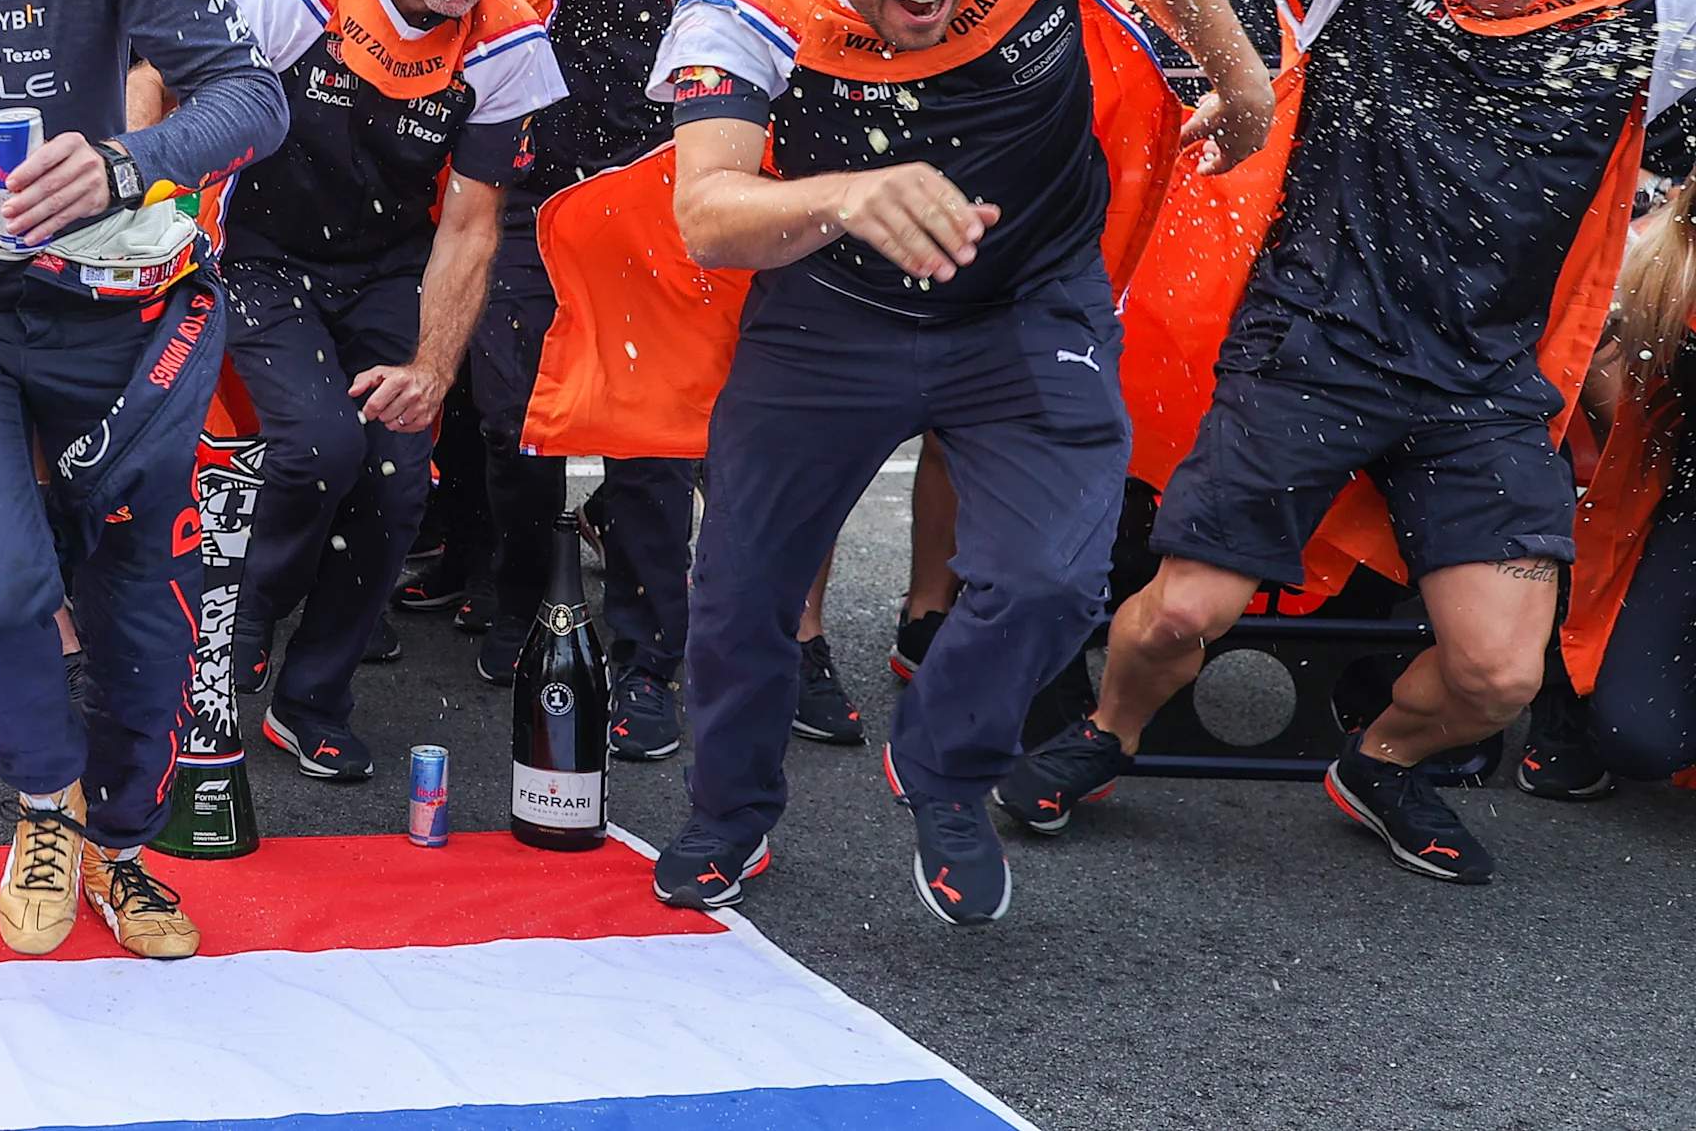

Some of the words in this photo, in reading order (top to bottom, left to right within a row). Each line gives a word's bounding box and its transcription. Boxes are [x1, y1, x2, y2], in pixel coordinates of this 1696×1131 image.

[1018, 4, 1066, 49] Tezos
[3, 47, 52, 64] Tezos
[342, 15, 368, 46] WIJ
[366, 39, 394, 73] ZIJN
[392, 55, 446, 79] ORANJE
[310, 65, 350, 89] Mobil
[305, 88, 355, 108] ORACL
[832, 77, 891, 103] Mobil
[407, 97, 452, 123] BYBIT
[148, 337, 194, 390] WINGS
[550, 691, 564, 707] 1
[519, 789, 591, 809] FERRARI
